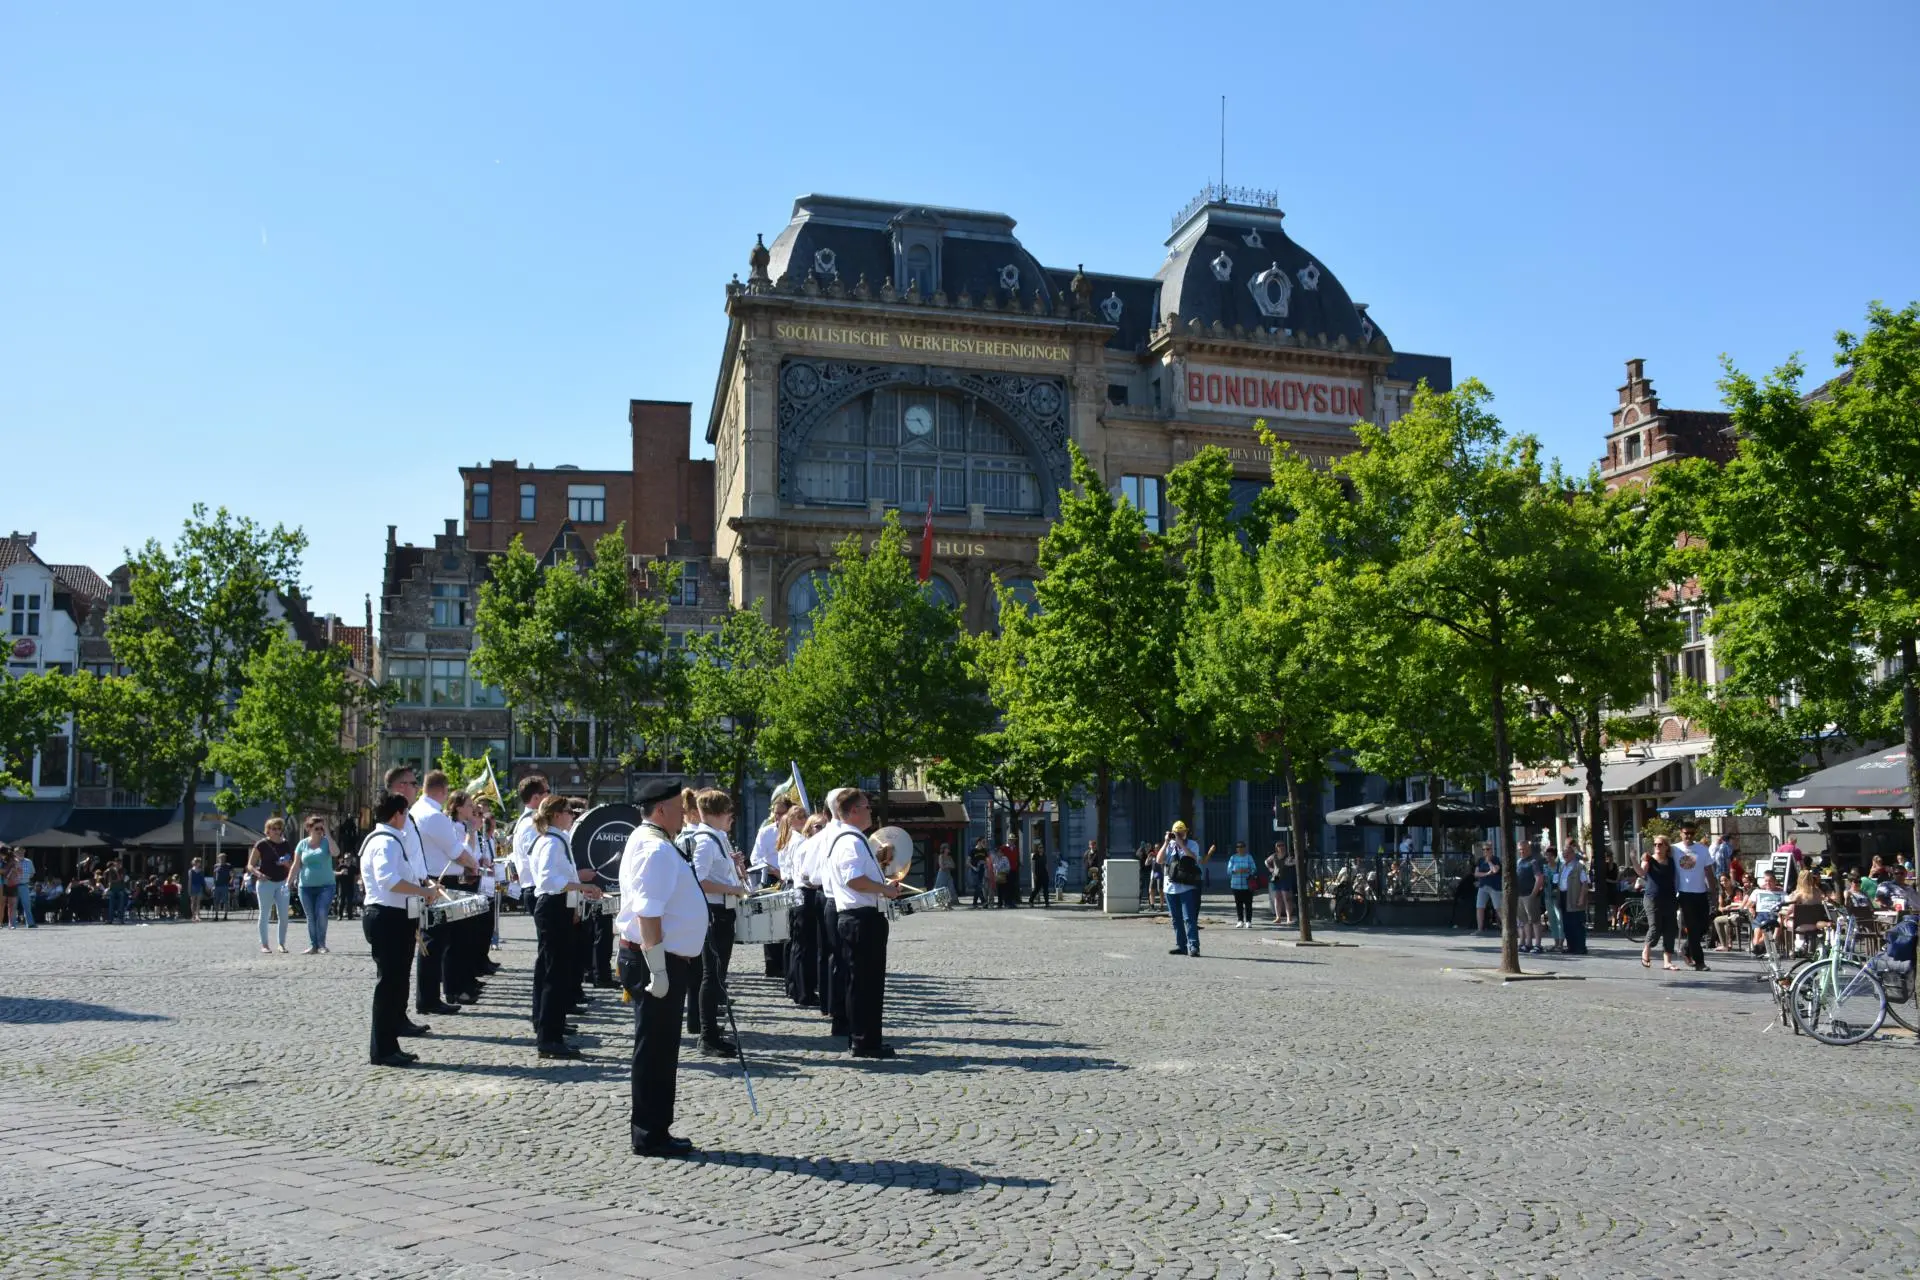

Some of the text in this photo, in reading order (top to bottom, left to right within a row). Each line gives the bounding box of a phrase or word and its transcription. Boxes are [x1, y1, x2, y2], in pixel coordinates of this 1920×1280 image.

[776, 323, 1070, 360] SOCIALISTISCHE WERKERSVEREENIGINGEN
[1189, 371, 1365, 416] BONDMOYSON
[870, 539, 985, 555] OS HUIS
[1694, 808, 1729, 819] BRASSERIE
